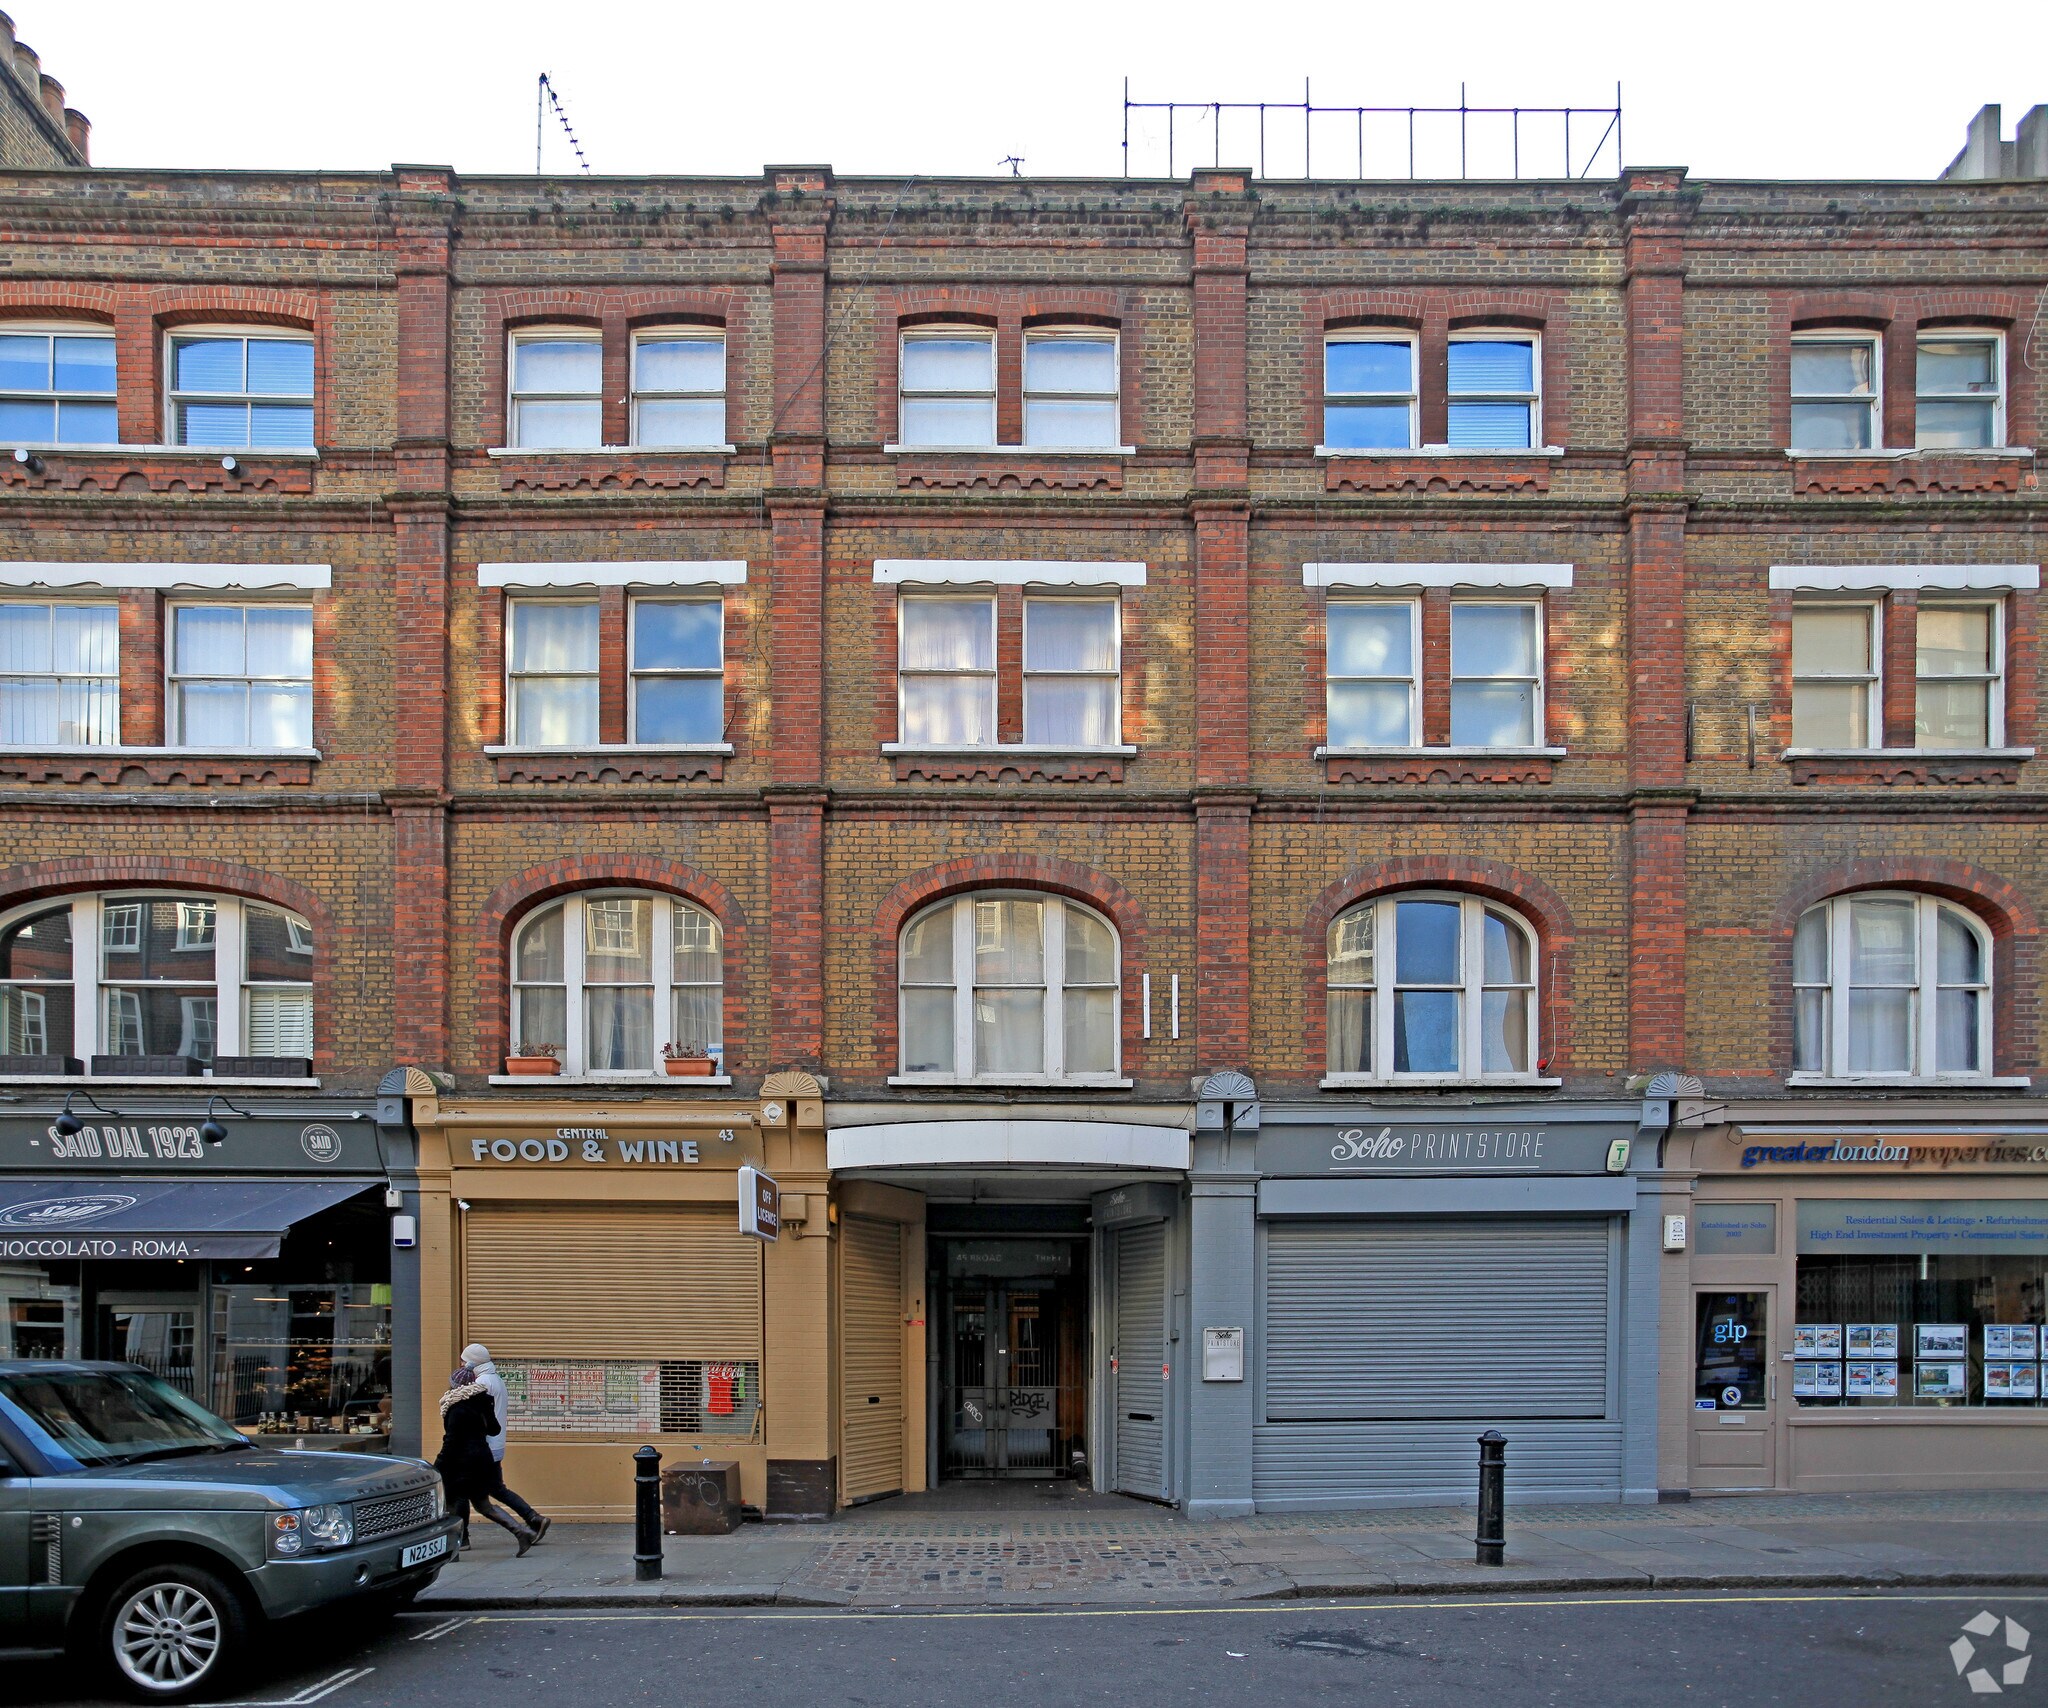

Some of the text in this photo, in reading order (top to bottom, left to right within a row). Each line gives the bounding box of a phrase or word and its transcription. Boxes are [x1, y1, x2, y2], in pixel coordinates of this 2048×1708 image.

[48, 1126, 103, 1158] SAID
[102, 1126, 150, 1158] DAL
[148, 1126, 204, 1158] 1923
[310, 1135, 332, 1149] SAID
[556, 1128, 609, 1140] CENTRAL
[718, 1129, 734, 1142] 43
[471, 1139, 699, 1163] FOOD & WINE
[1330, 1127, 1546, 1161] Soho PRINTSTORE
[762, 1189, 772, 1205] OFF
[757, 1206, 777, 1226] LICENCE
[1845, 1215, 1897, 1225] Residential
[1899, 1215, 1925, 1225] Sales
[1810, 1230, 1833, 1241] High
[1835, 1230, 1854, 1239] End
[0, 1240, 117, 1256] IOCCOLATO
[132, 1240, 190, 1256] ROMA
[1714, 1318, 1748, 1344] glp
[409, 1538, 444, 1563] N22 SSJ
